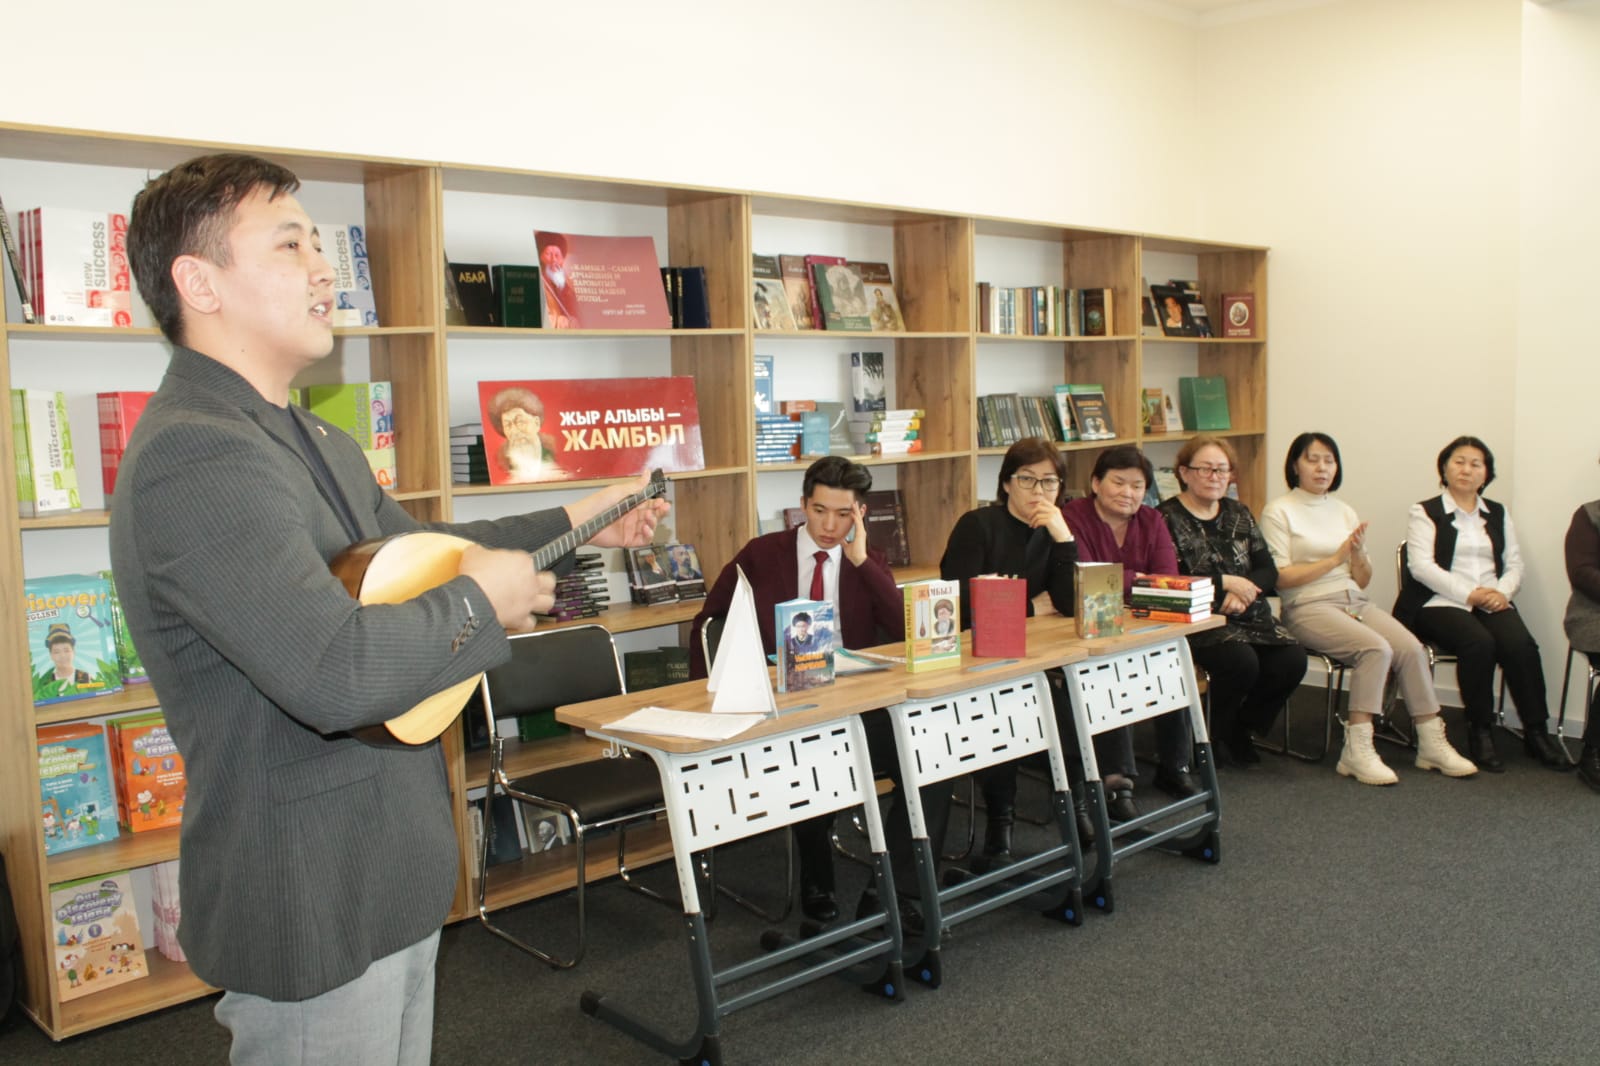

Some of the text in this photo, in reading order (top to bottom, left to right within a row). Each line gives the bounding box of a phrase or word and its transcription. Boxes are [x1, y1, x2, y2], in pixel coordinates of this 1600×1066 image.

[93, 221, 107, 288] success
[336, 230, 353, 289] success
[84, 263, 93, 287] new
[459, 271, 487, 283] АБАЙ
[355, 386, 369, 449] success
[560, 411, 600, 426] ЖЫР
[604, 408, 665, 424] АЛЫБЫ
[48, 400, 61, 468] success
[561, 424, 685, 452] ЖАМБЫЛ
[918, 586, 953, 598] ЖАМБЫЛ
[57, 894, 122, 919] Discovery
[75, 892, 99, 904] Our
[71, 907, 112, 925] Island
